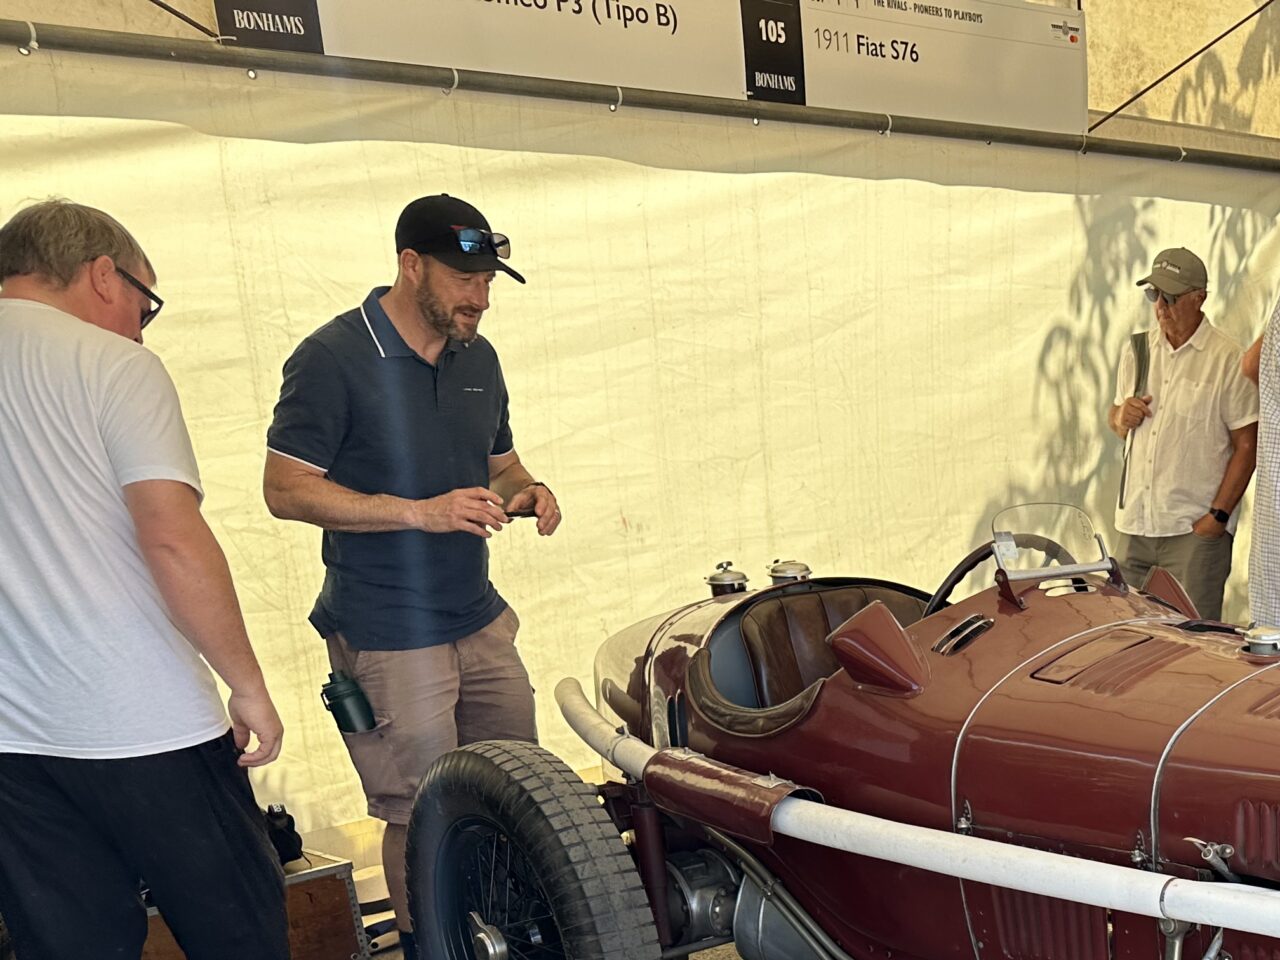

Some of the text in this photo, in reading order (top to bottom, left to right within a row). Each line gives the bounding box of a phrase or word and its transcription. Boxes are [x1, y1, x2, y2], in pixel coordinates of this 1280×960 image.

[233, 9, 305, 35] BONHAMS
[656, 3, 678, 35] B)
[887, 0, 908, 11] RIVALS
[914, 3, 943, 17] PIONEERS
[944, 8, 953, 19] TO
[953, 10, 983, 23] PLAYBOYS
[759, 18, 786, 44] 105
[814, 27, 919, 62] 1911 Fiat S76
[754, 71, 796, 91] BONHAMS
